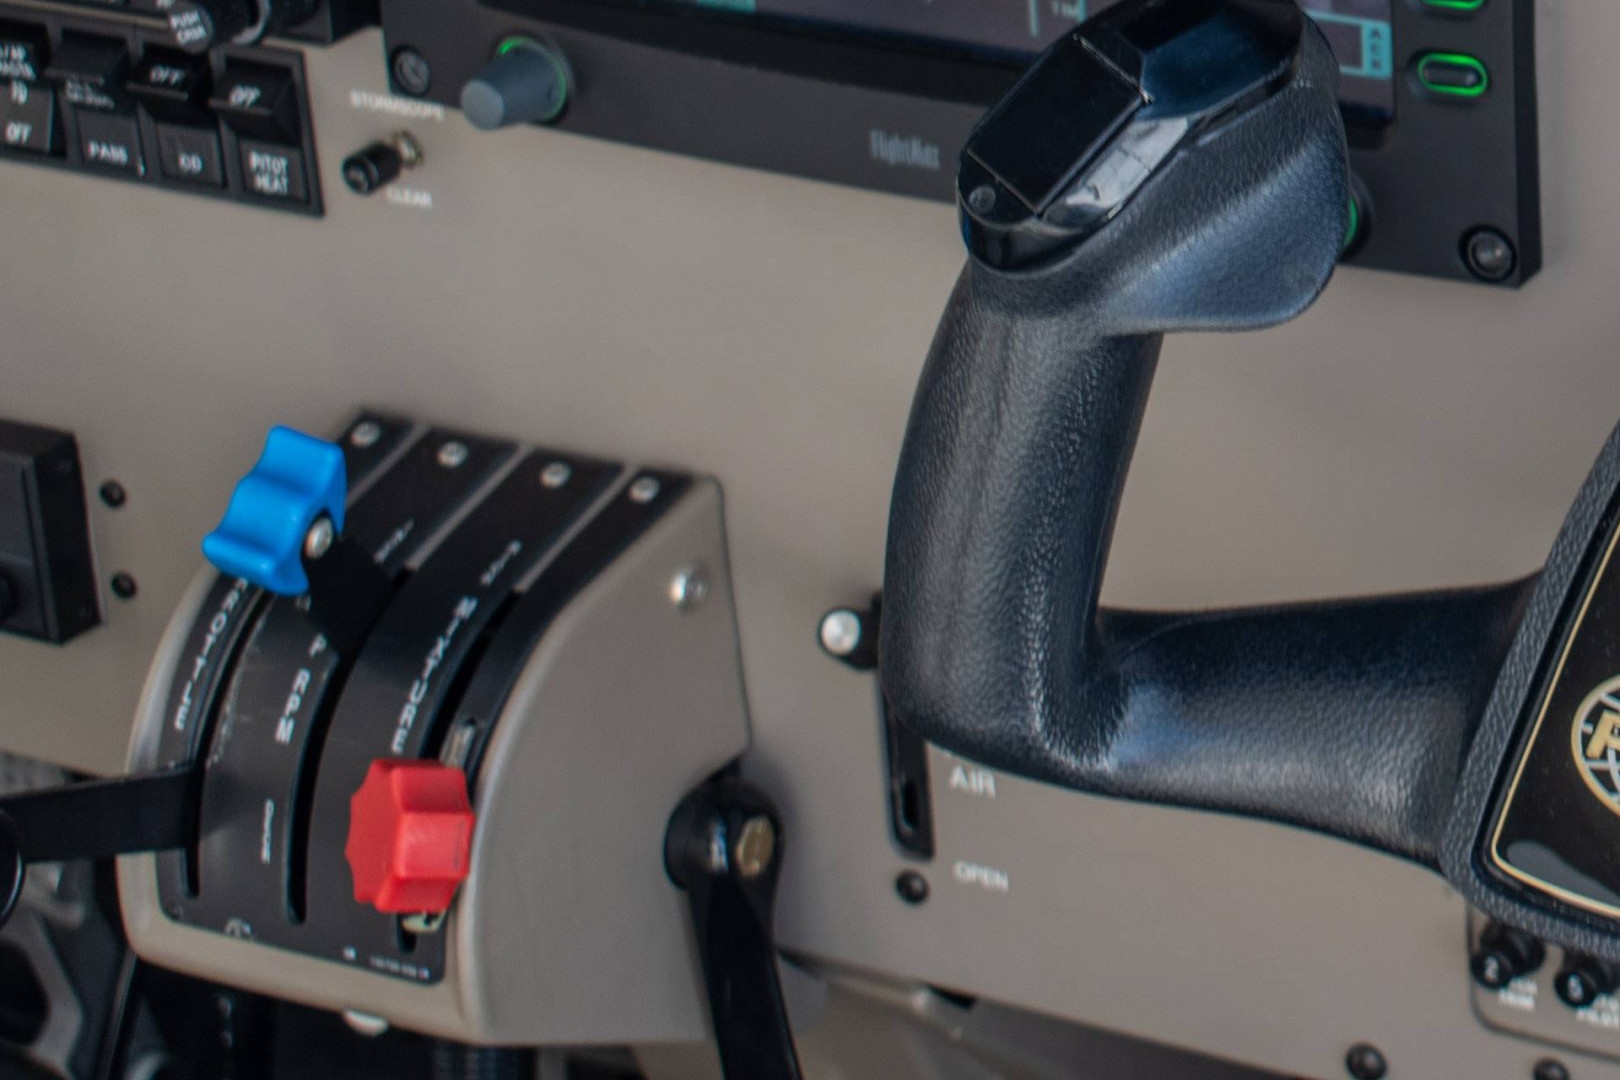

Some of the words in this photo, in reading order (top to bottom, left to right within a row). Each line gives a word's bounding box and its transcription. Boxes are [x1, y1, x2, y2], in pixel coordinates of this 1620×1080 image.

[150, 65, 185, 86] OFF
[89, 142, 128, 165] PASS
[250, 151, 289, 175] PITOT
[253, 173, 290, 195] HEAT
[950, 766, 996, 800] AIR
[954, 859, 1009, 892] OPEN
